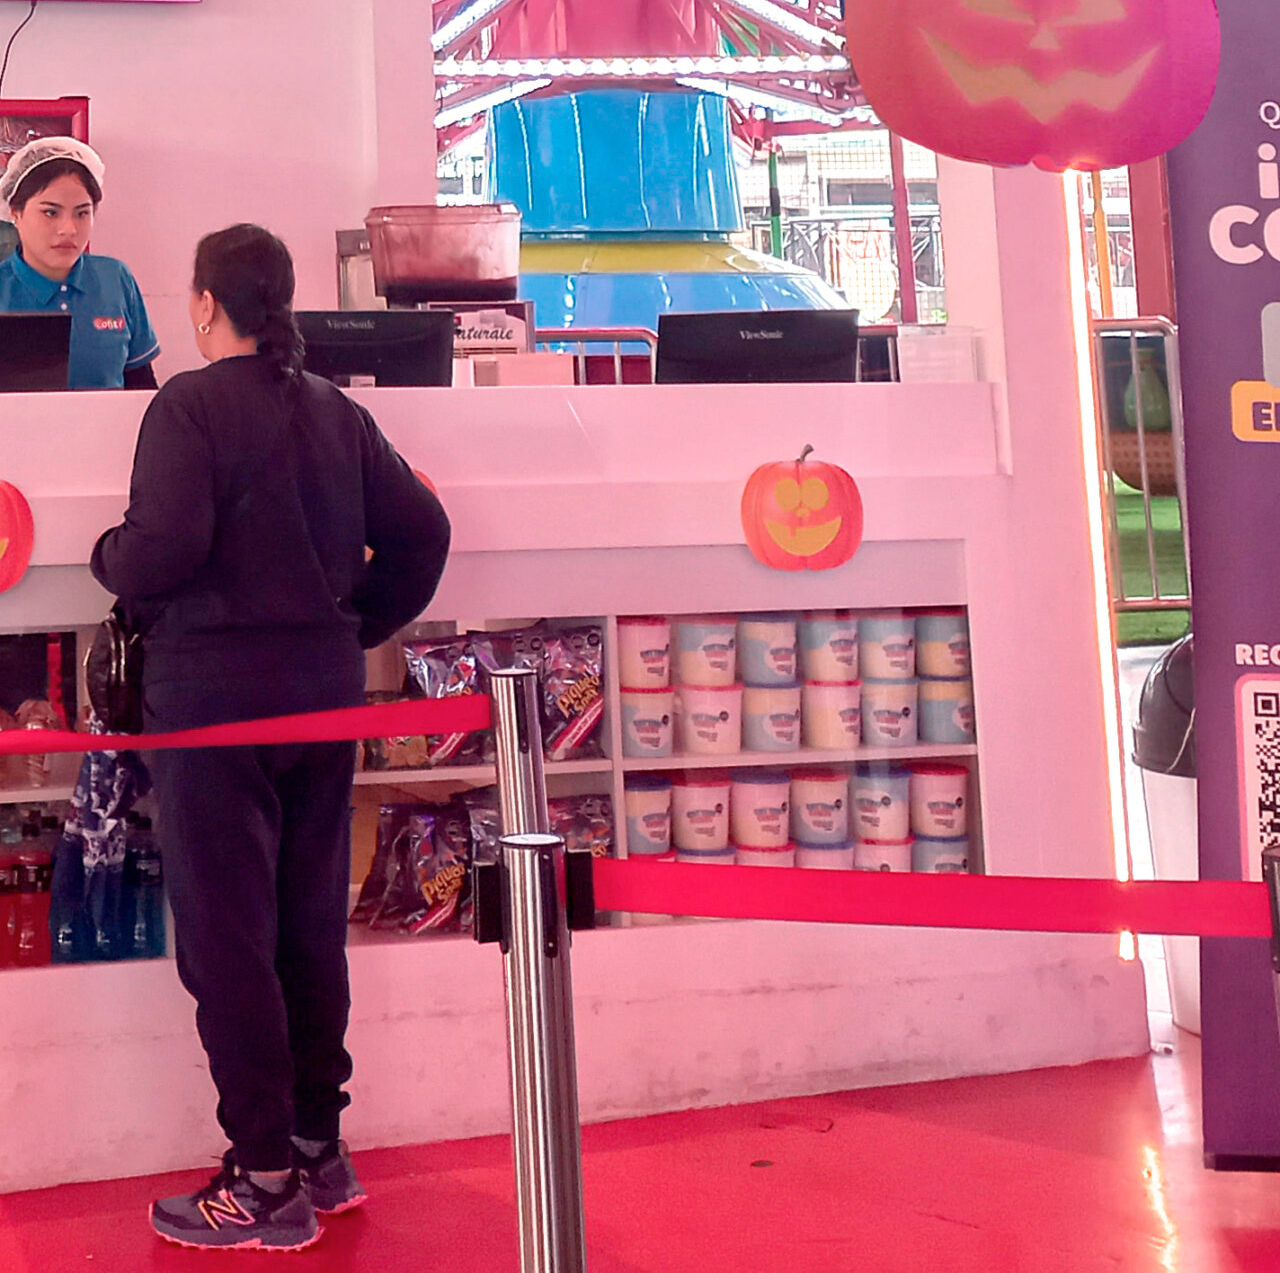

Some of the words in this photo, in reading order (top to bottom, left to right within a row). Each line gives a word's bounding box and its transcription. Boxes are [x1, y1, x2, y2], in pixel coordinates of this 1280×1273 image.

[326, 318, 376, 329] ViewSonic
[739, 329, 784, 340] ViewSonic
[556, 675, 601, 719] Piqueo
[421, 862, 467, 905] Piqueo
